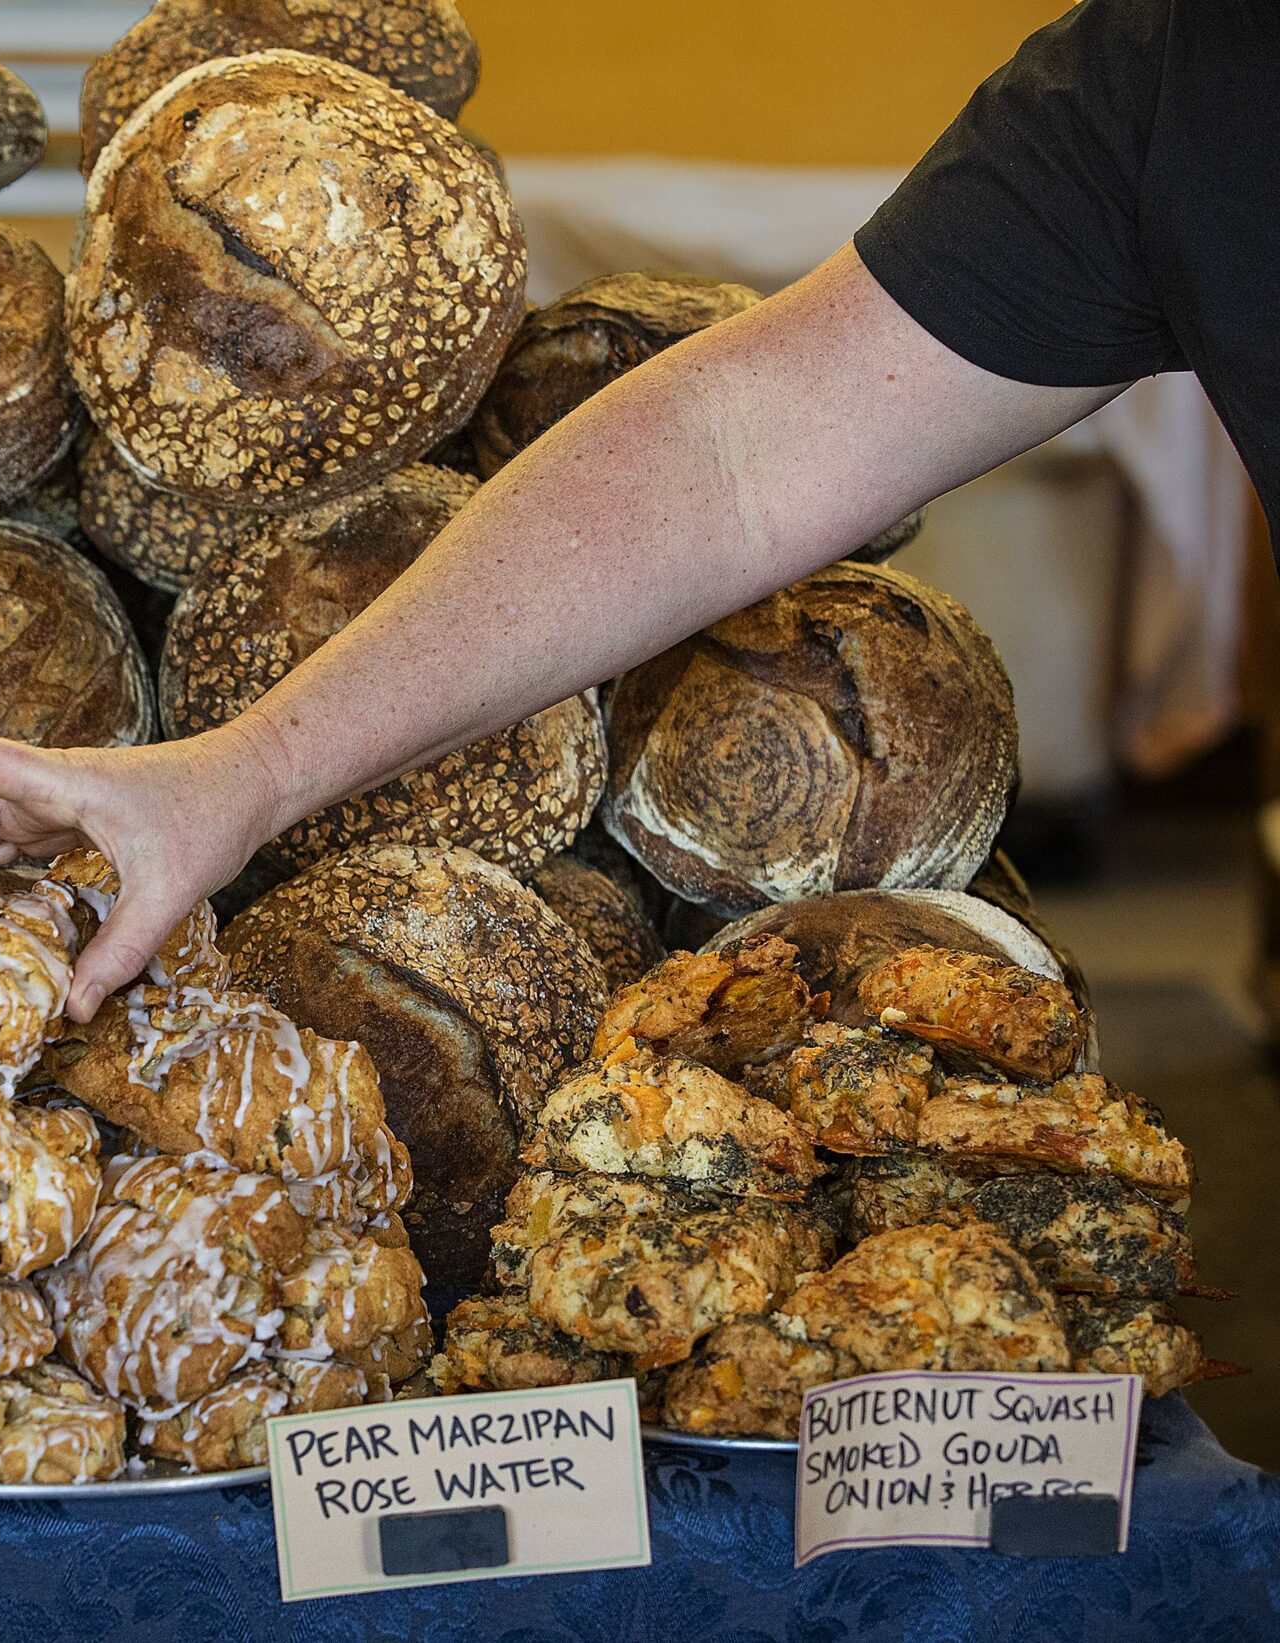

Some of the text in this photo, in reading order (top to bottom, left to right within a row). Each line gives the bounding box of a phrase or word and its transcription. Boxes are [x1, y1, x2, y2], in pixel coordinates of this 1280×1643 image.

[286, 1407, 615, 1475] PEAR MARZIPAN
[806, 1386, 1115, 1443] BUTTERNUT SQUASH
[316, 1456, 585, 1517] ROSE WATER
[806, 1433, 1062, 1484] SMOKED GOUDA
[826, 1475, 931, 1513] ONION
